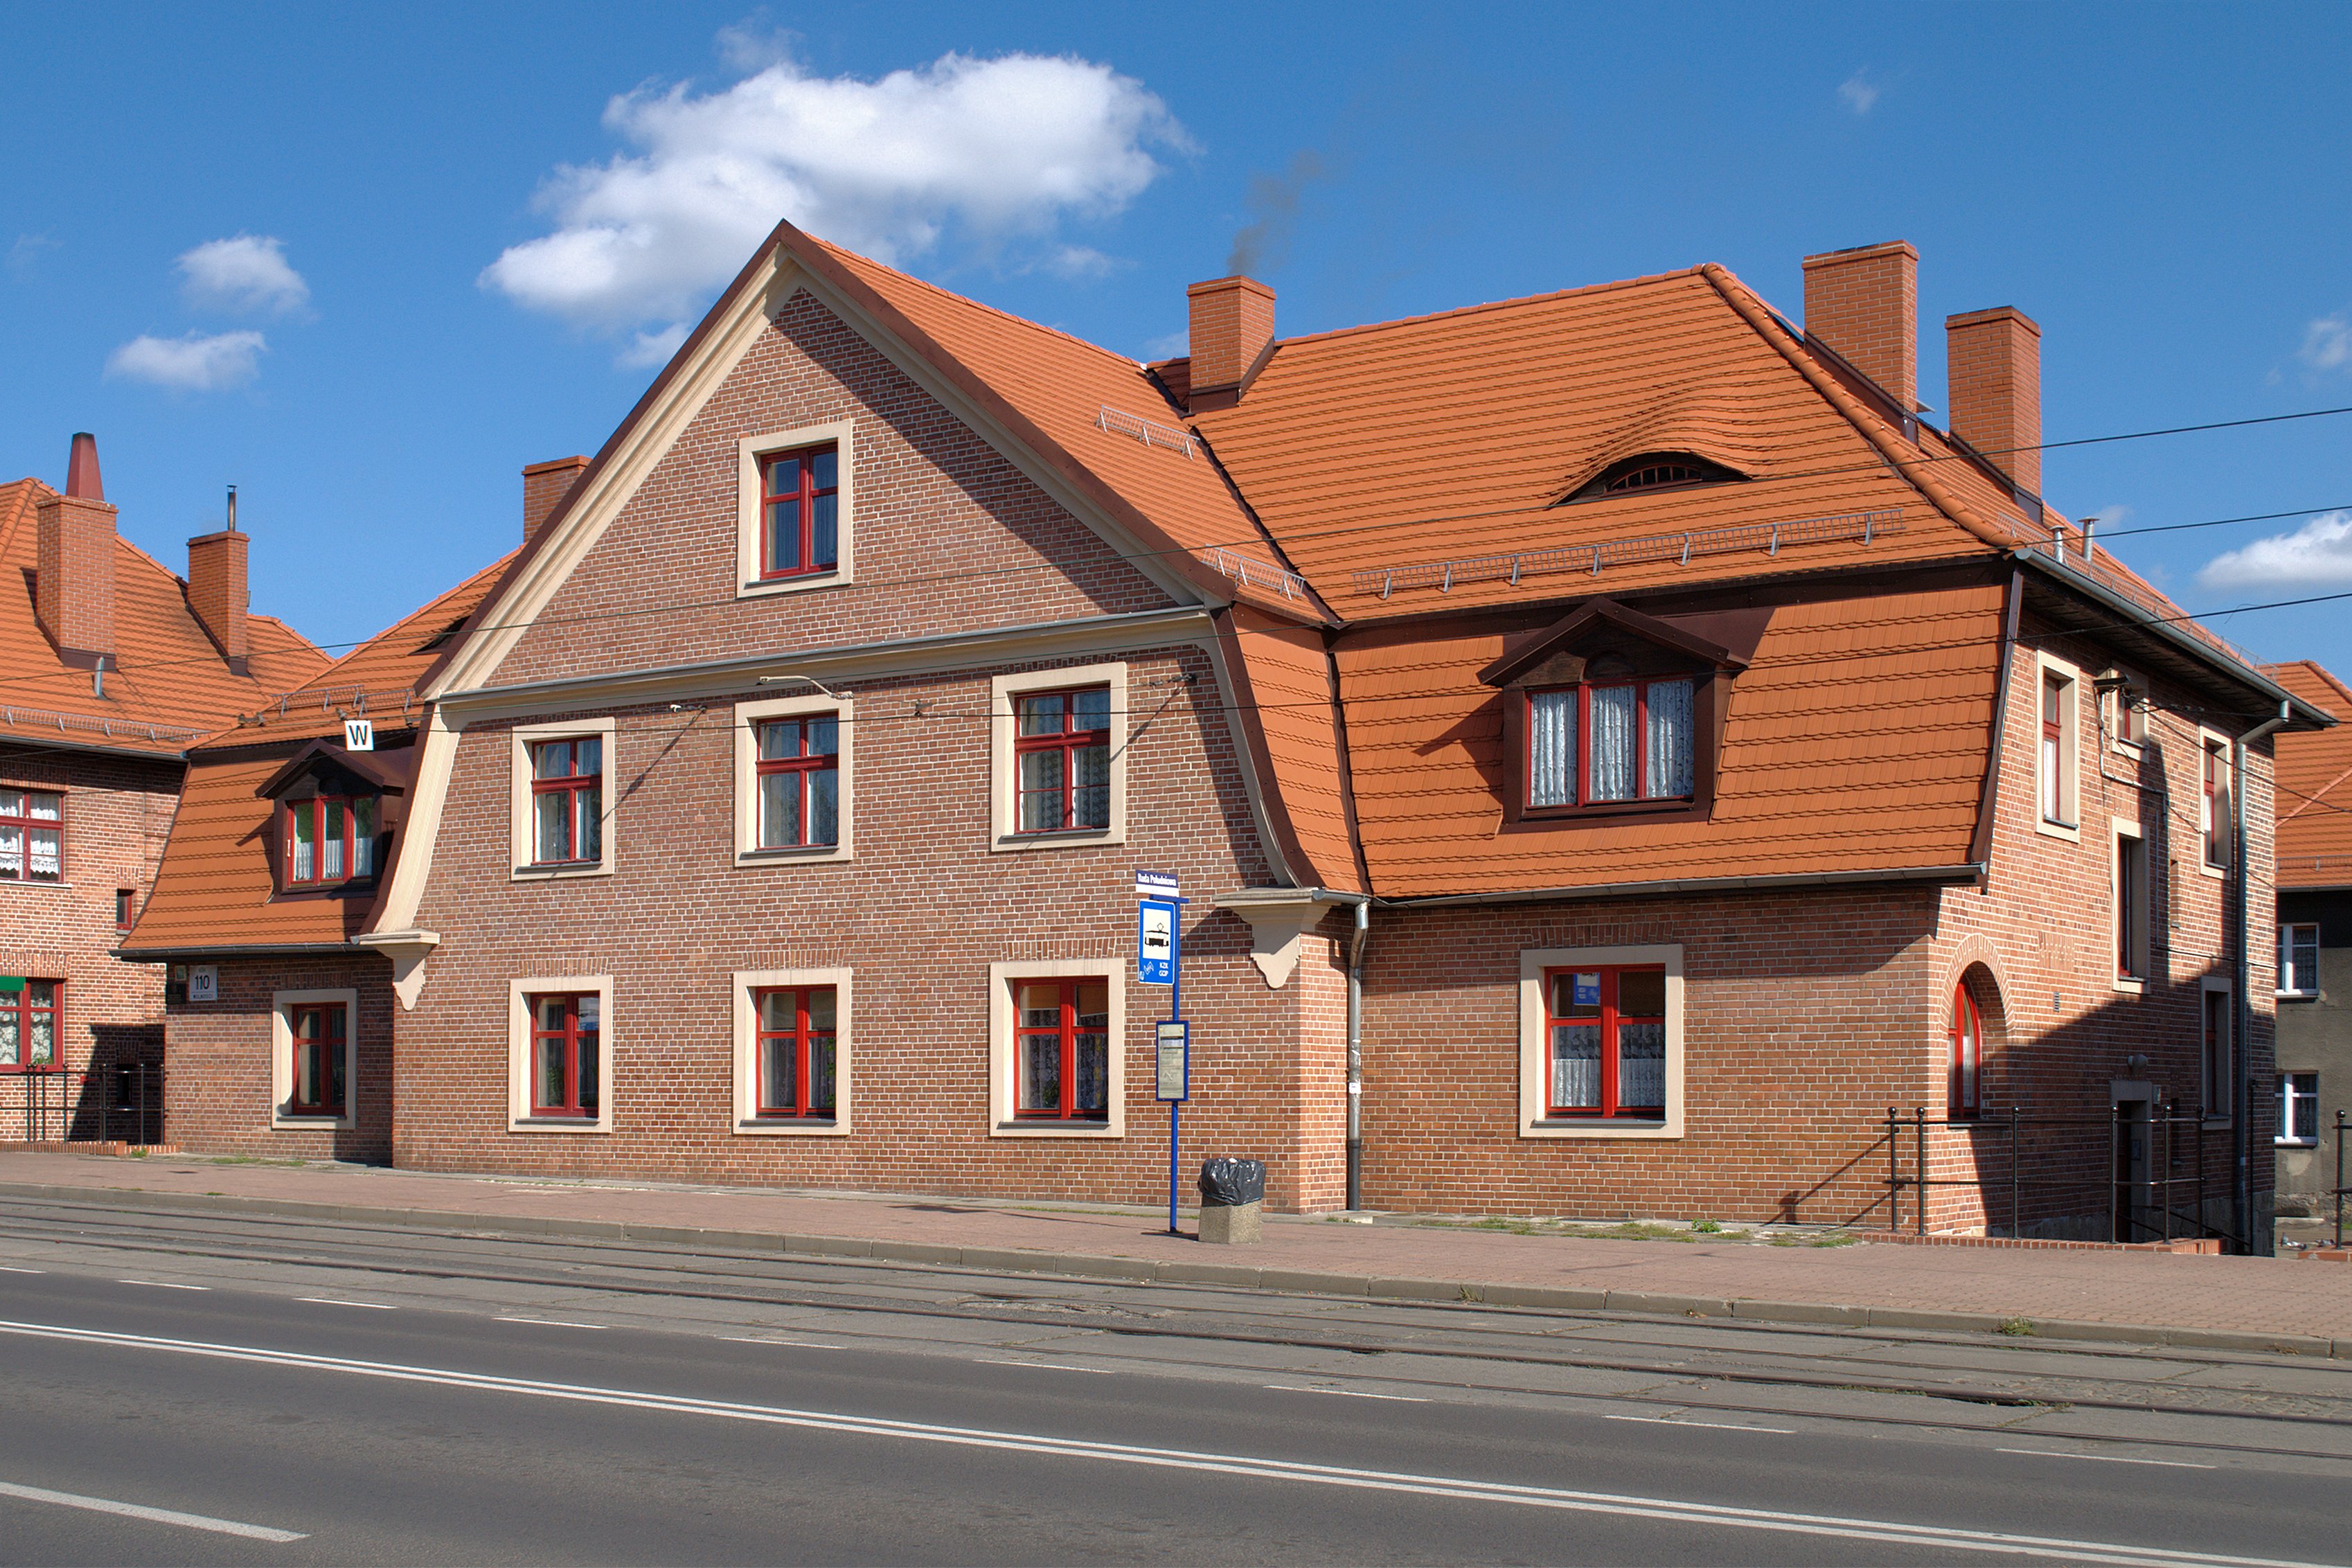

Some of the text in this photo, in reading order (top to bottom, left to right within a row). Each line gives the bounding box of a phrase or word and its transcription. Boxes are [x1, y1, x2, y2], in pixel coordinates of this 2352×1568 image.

[348, 725, 368, 745] W
[1137, 873, 1150, 884] Ruda
[195, 974, 211, 990] 110
